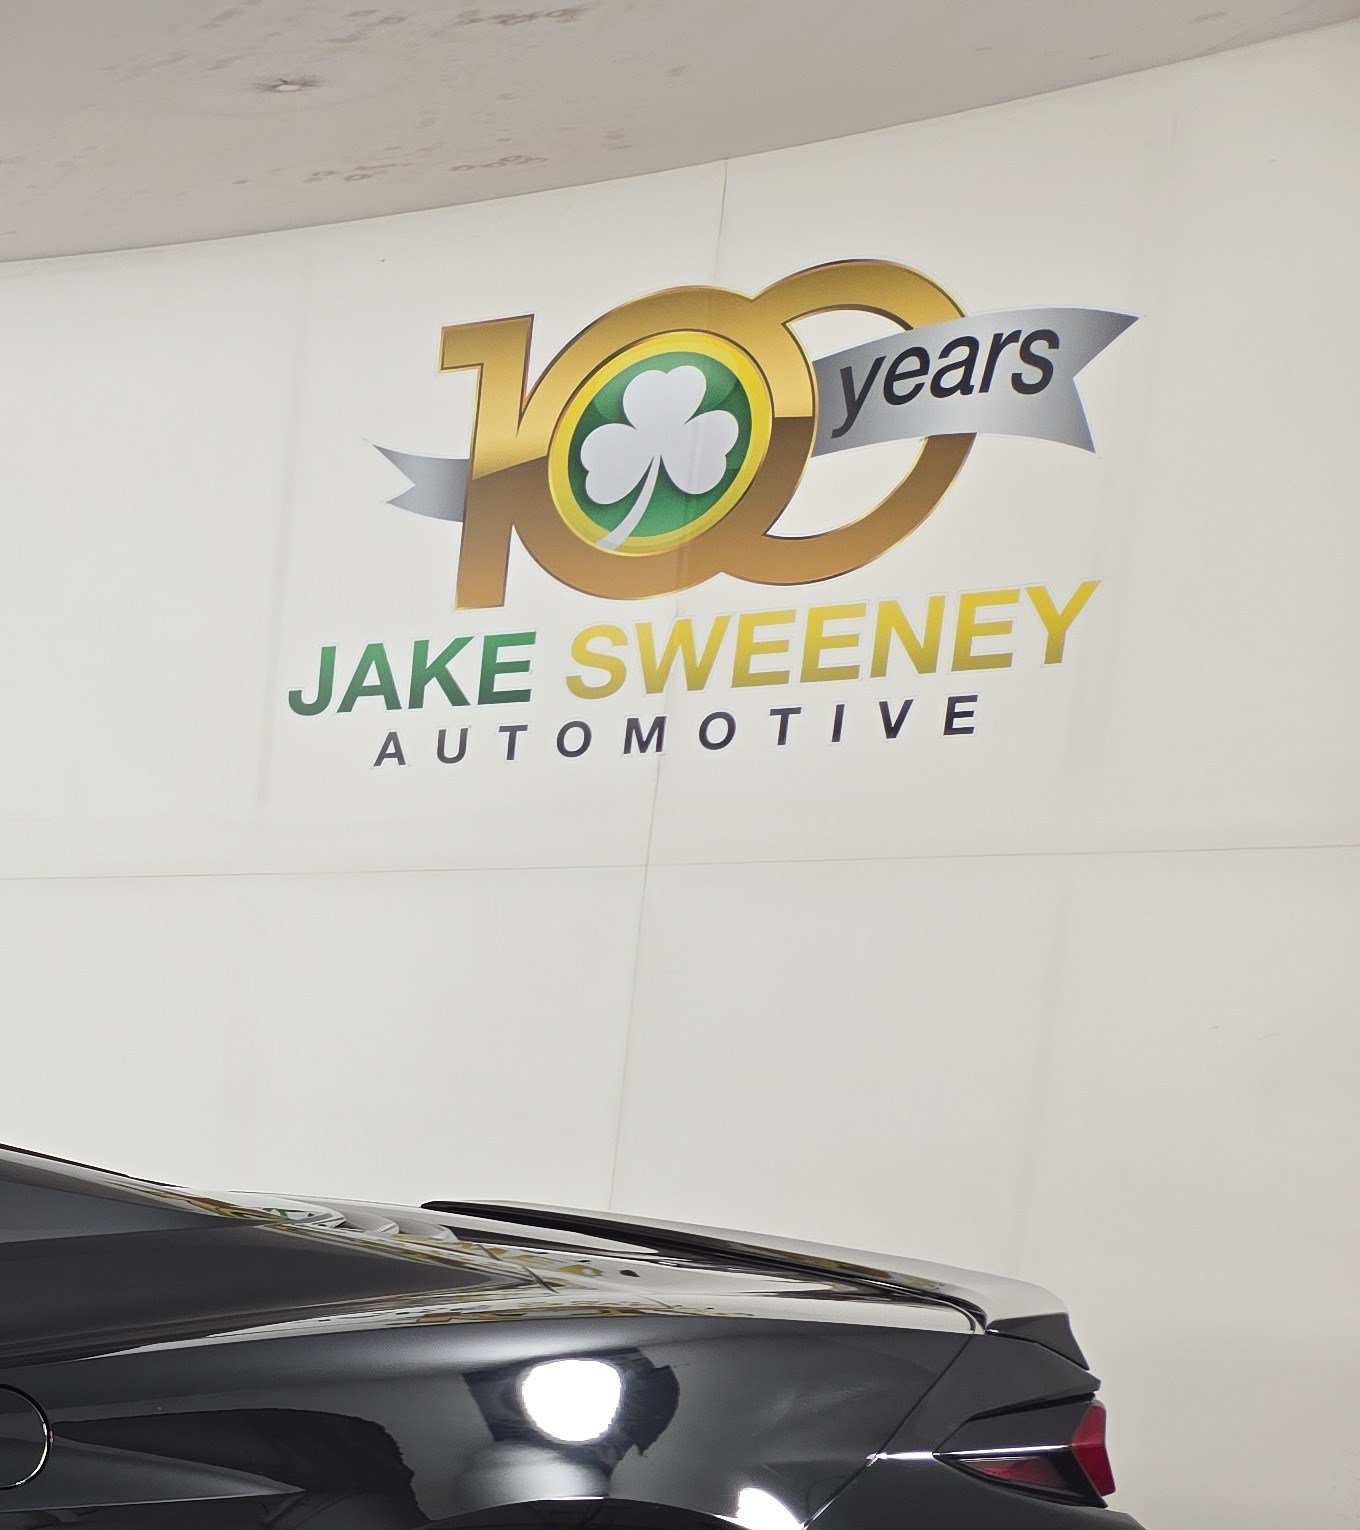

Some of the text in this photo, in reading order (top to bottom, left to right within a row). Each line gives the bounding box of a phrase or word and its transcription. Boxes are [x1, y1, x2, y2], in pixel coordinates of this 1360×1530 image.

[830, 325, 1061, 440] years
[287, 580, 1102, 717] JAKE SWEENEY
[372, 694, 980, 768] AUTOMOTIVE
